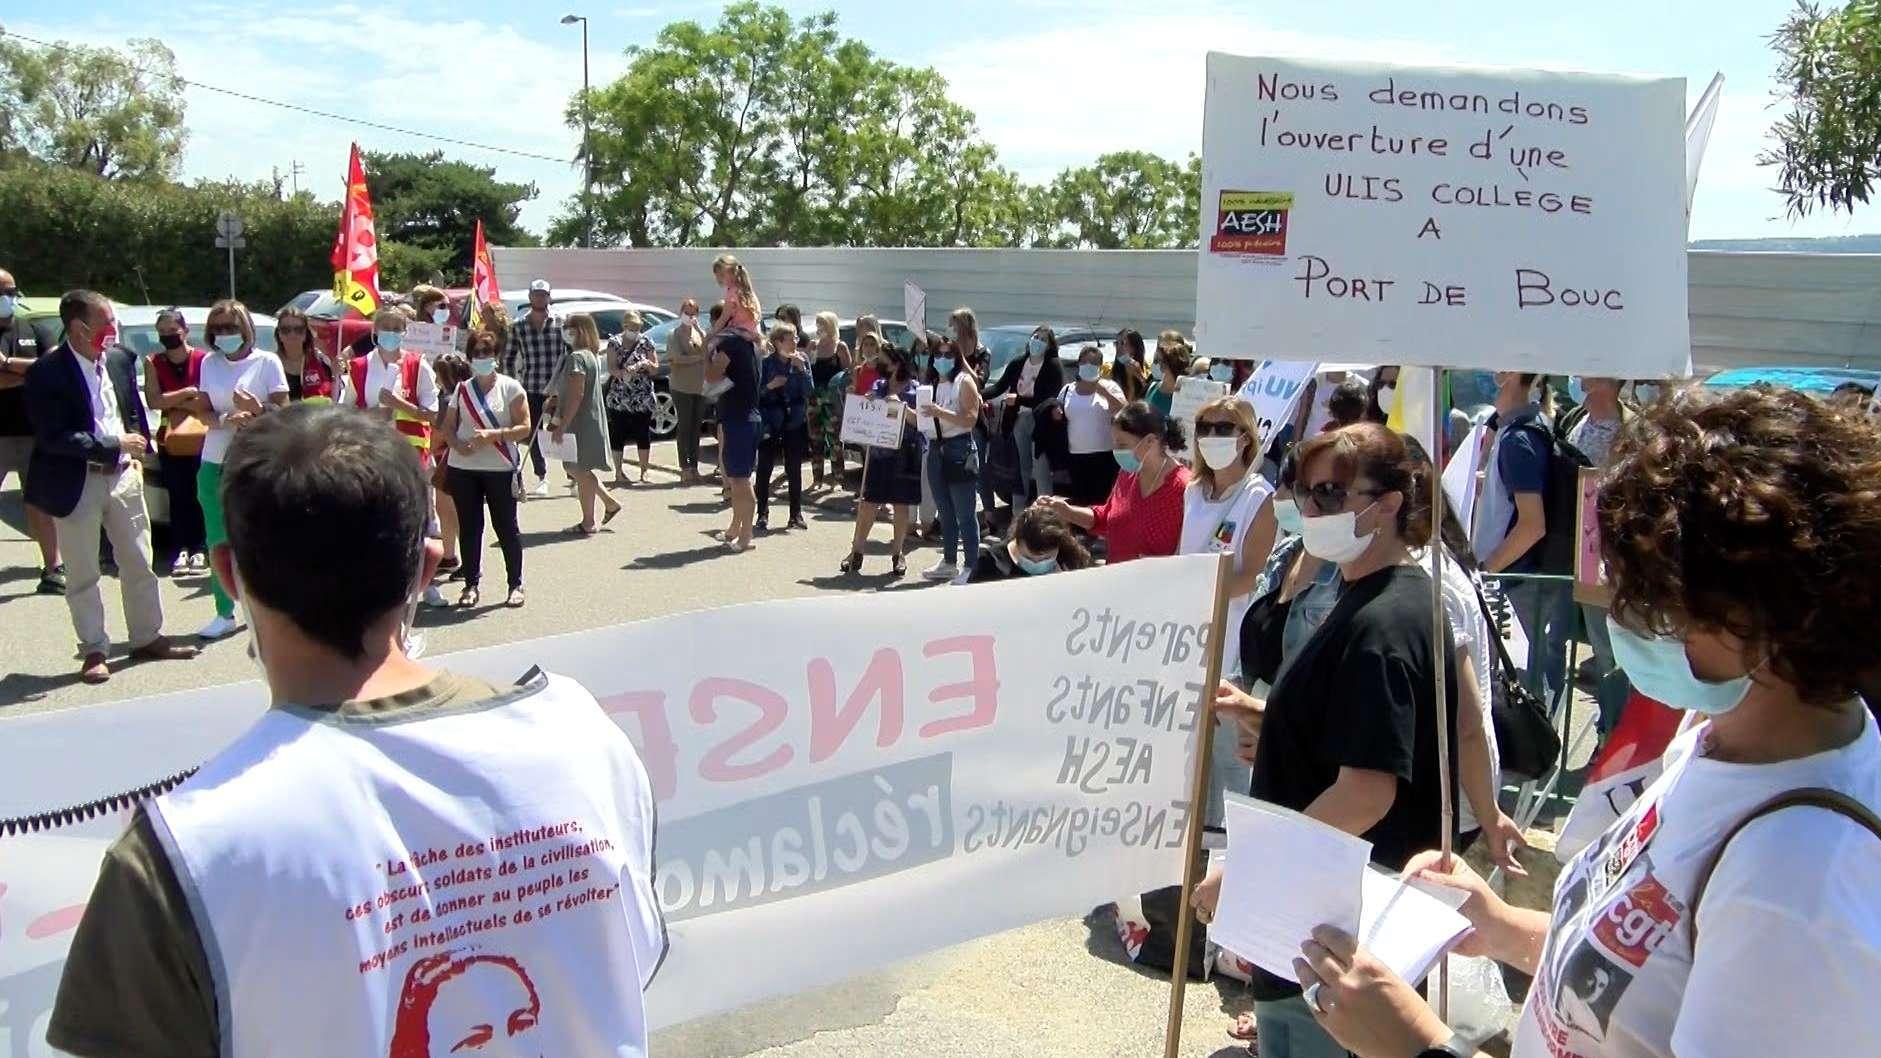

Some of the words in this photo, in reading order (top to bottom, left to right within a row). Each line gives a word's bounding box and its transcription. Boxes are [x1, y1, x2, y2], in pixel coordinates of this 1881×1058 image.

[1258, 73, 1338, 102] Nous
[1368, 78, 1588, 125] demandons
[1261, 110, 1447, 156] l'ouverture
[1469, 126, 1569, 170] d'une
[1325, 173, 1403, 201] ULIS
[1220, 211, 1282, 235] AESH
[1417, 218, 1441, 240] A
[1418, 280, 1467, 307] DE
[407, 848, 448, 869] âche
[455, 842, 485, 858] des
[345, 901, 373, 921] ces
[434, 867, 492, 890] soldats
[498, 861, 518, 877] de
[523, 855, 536, 870] la
[384, 913, 405, 934] est
[410, 908, 431, 924] de
[435, 894, 486, 918] donner
[492, 889, 510, 903] au
[517, 874, 564, 902] peuple
[569, 869, 590, 884] les
[359, 941, 408, 974] moyens
[414, 914, 507, 948] intellectuels
[513, 910, 533, 925] de
[538, 904, 552, 918] se
